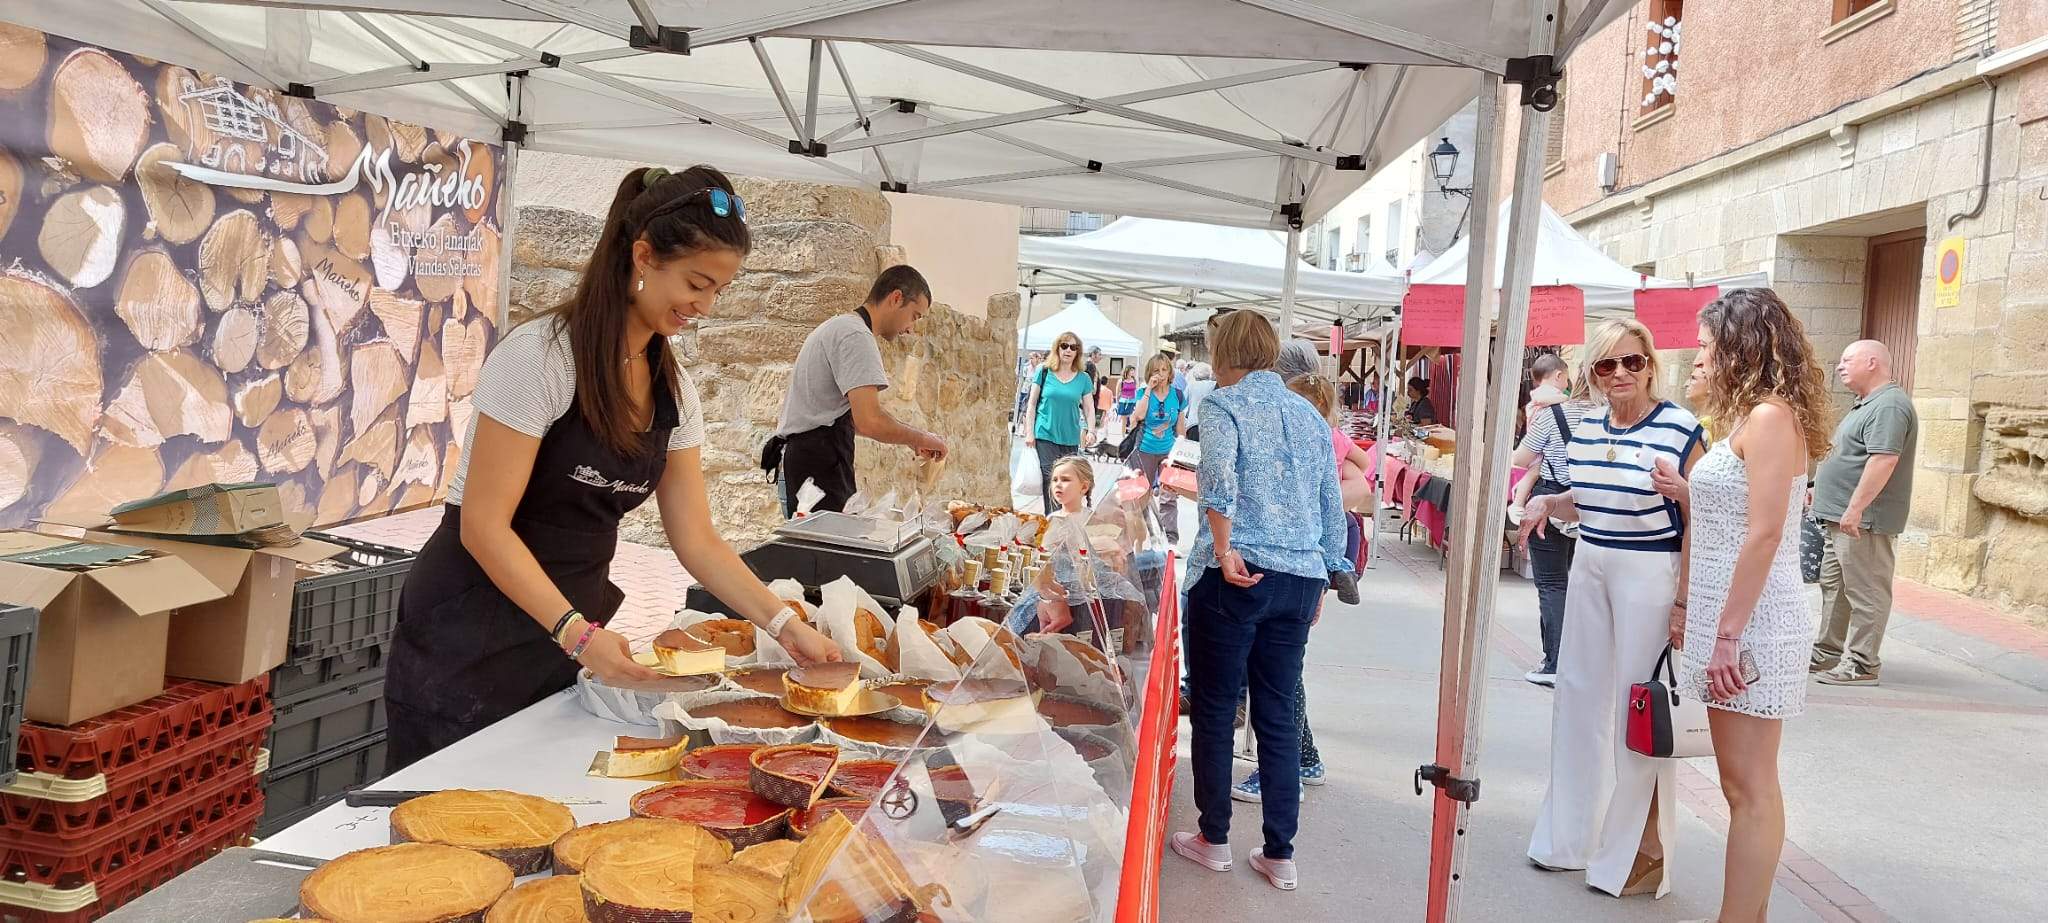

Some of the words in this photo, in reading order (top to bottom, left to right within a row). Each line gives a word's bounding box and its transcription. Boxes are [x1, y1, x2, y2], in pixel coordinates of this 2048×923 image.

[345, 138, 485, 229] Mañeko
[389, 222, 437, 250] Etxeko
[315, 257, 361, 303] Mañeko
[408, 255, 446, 276] Viandas
[448, 256, 482, 277] Selectas
